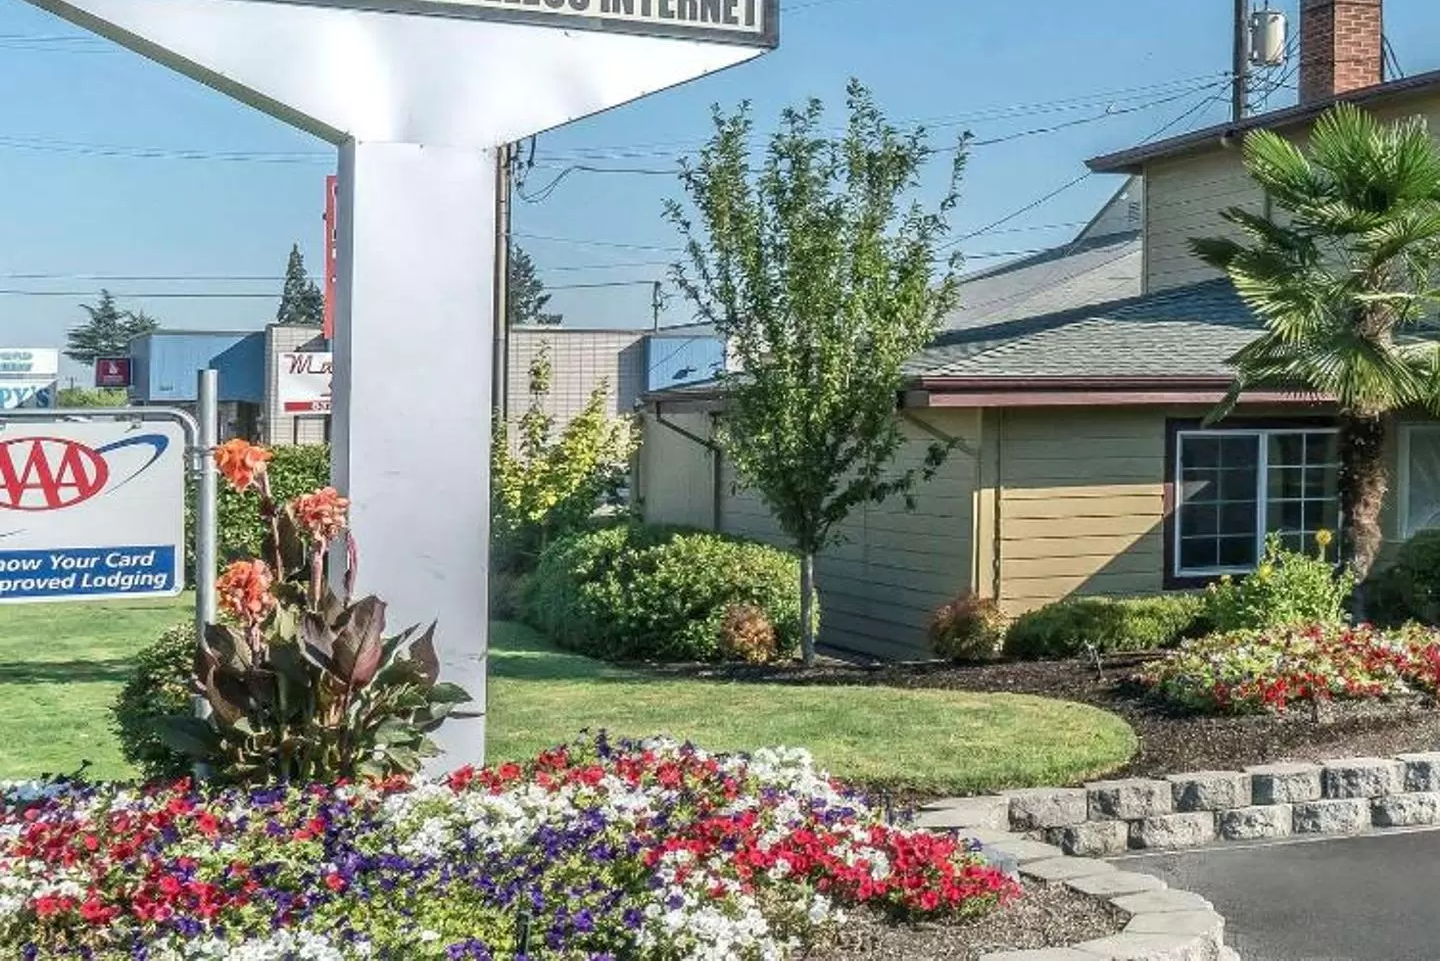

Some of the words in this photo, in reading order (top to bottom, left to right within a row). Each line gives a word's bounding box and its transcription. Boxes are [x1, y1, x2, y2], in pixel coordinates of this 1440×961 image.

[50, 553, 100, 570] Your
[105, 550, 155, 569] Card
[0, 572, 76, 594] proved
[81, 568, 168, 591] Lodging
